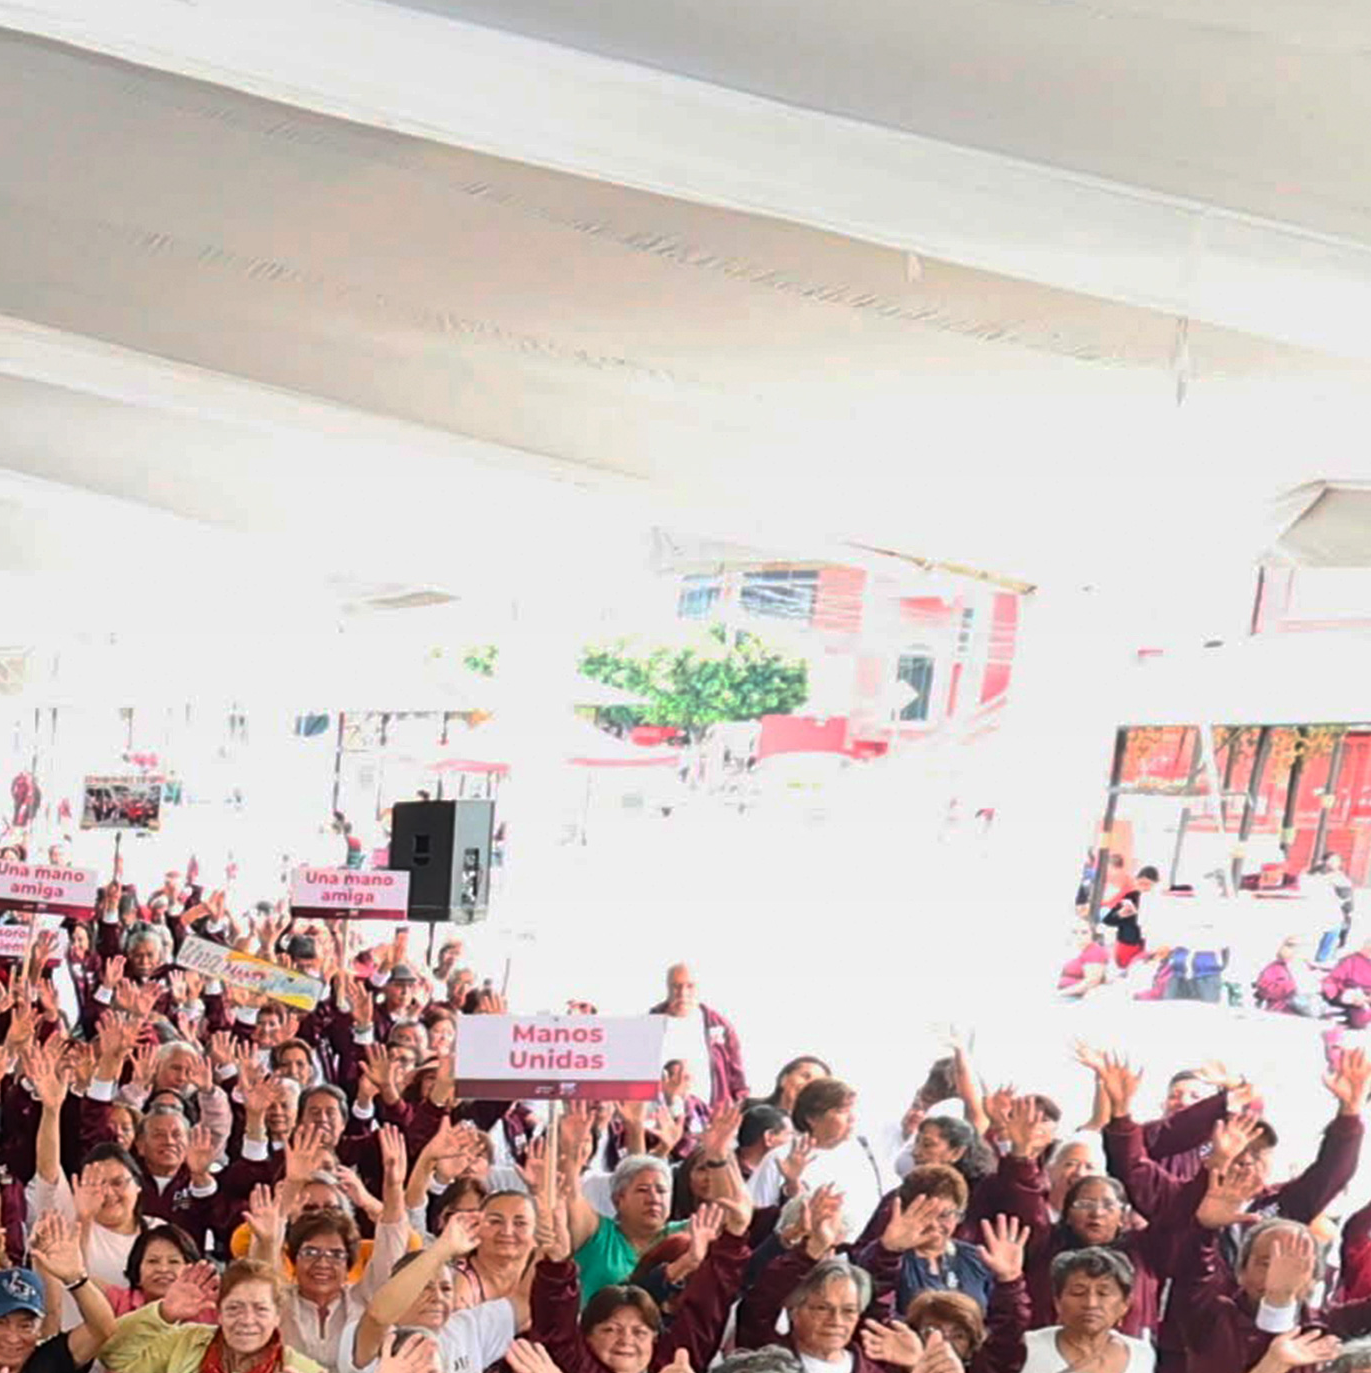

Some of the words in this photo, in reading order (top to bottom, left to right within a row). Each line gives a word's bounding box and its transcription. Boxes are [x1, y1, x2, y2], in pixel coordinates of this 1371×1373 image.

[34, 867, 85, 883] mano
[305, 871, 342, 885] Una
[345, 873, 394, 886] mano
[10, 881, 64, 898] amiga
[321, 889, 375, 905] amiga
[512, 1025, 604, 1043] Manos
[509, 1049, 604, 1069] Unidas
